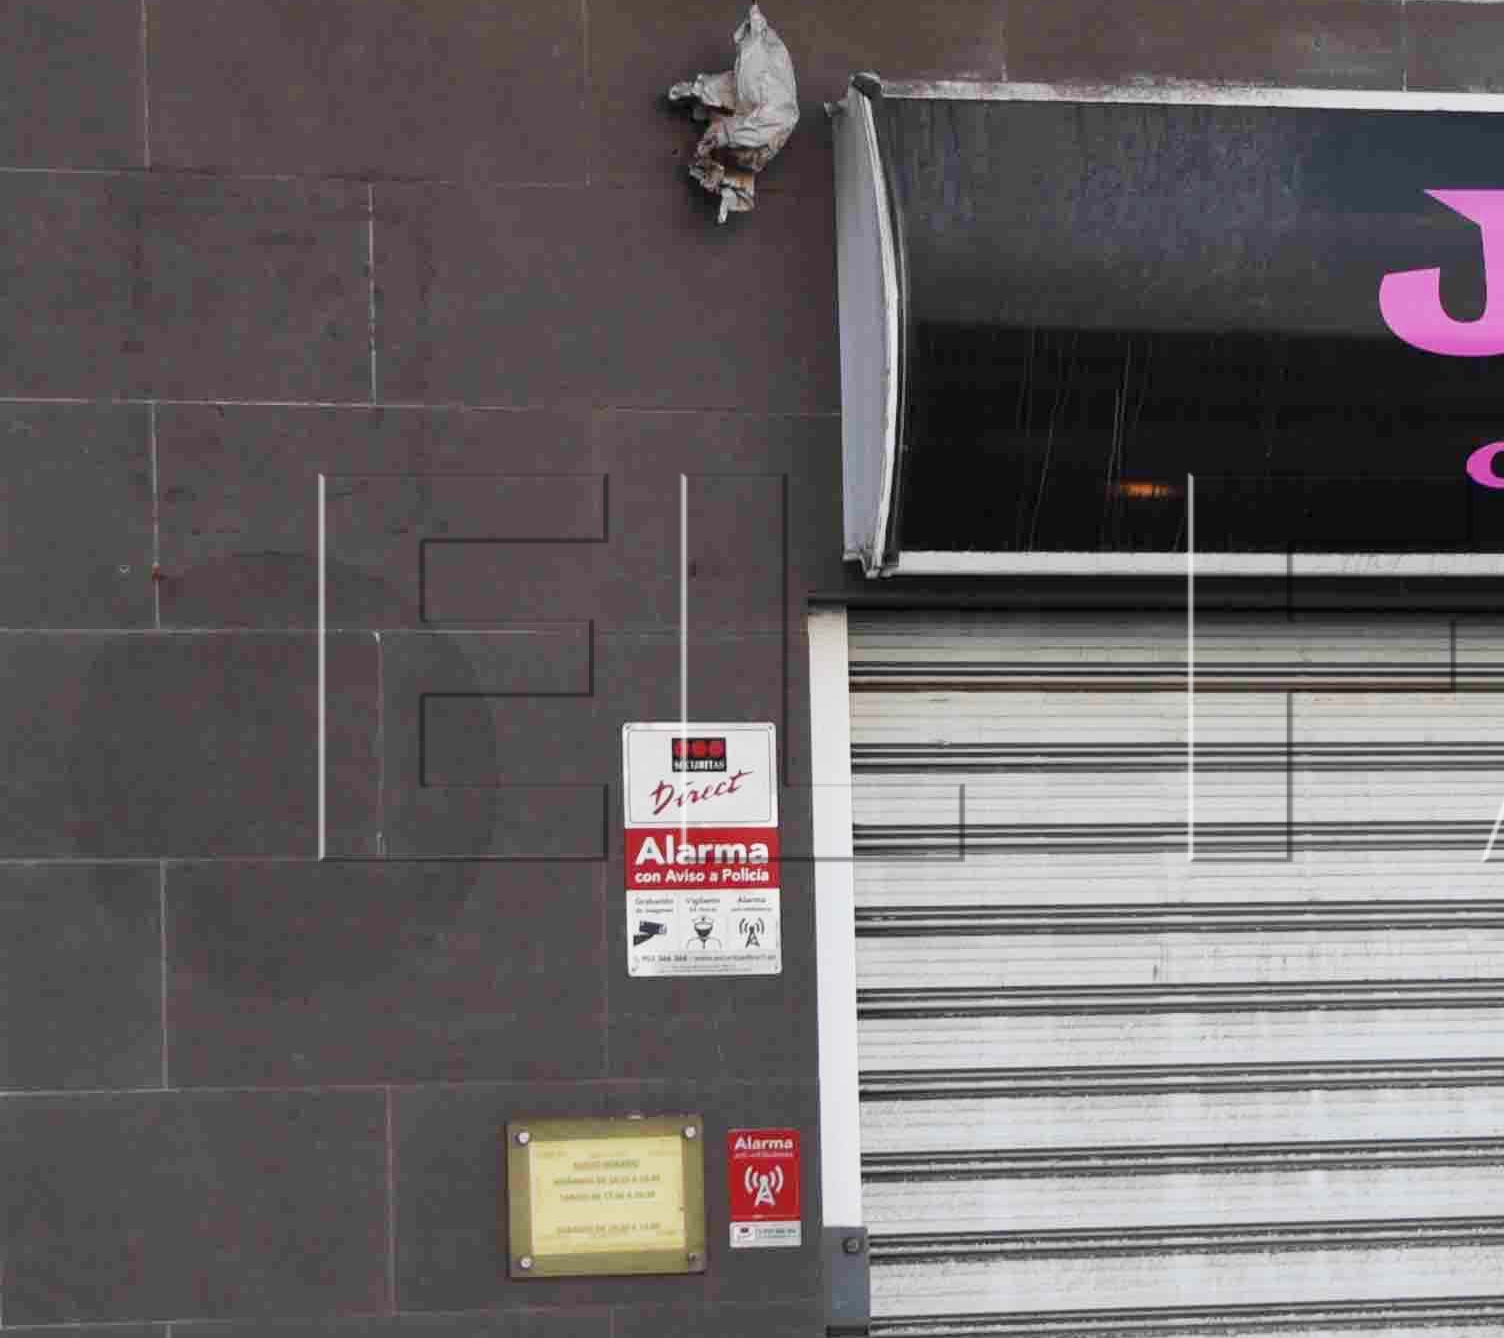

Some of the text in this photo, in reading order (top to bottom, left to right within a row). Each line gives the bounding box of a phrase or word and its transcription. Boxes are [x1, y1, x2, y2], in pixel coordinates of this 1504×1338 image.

[649, 768, 754, 816] Direct
[634, 834, 769, 865] Alarma
[634, 870, 662, 883] con
[665, 868, 706, 883] Aviso
[709, 871, 719, 882] a
[734, 1135, 794, 1150] Alarma
